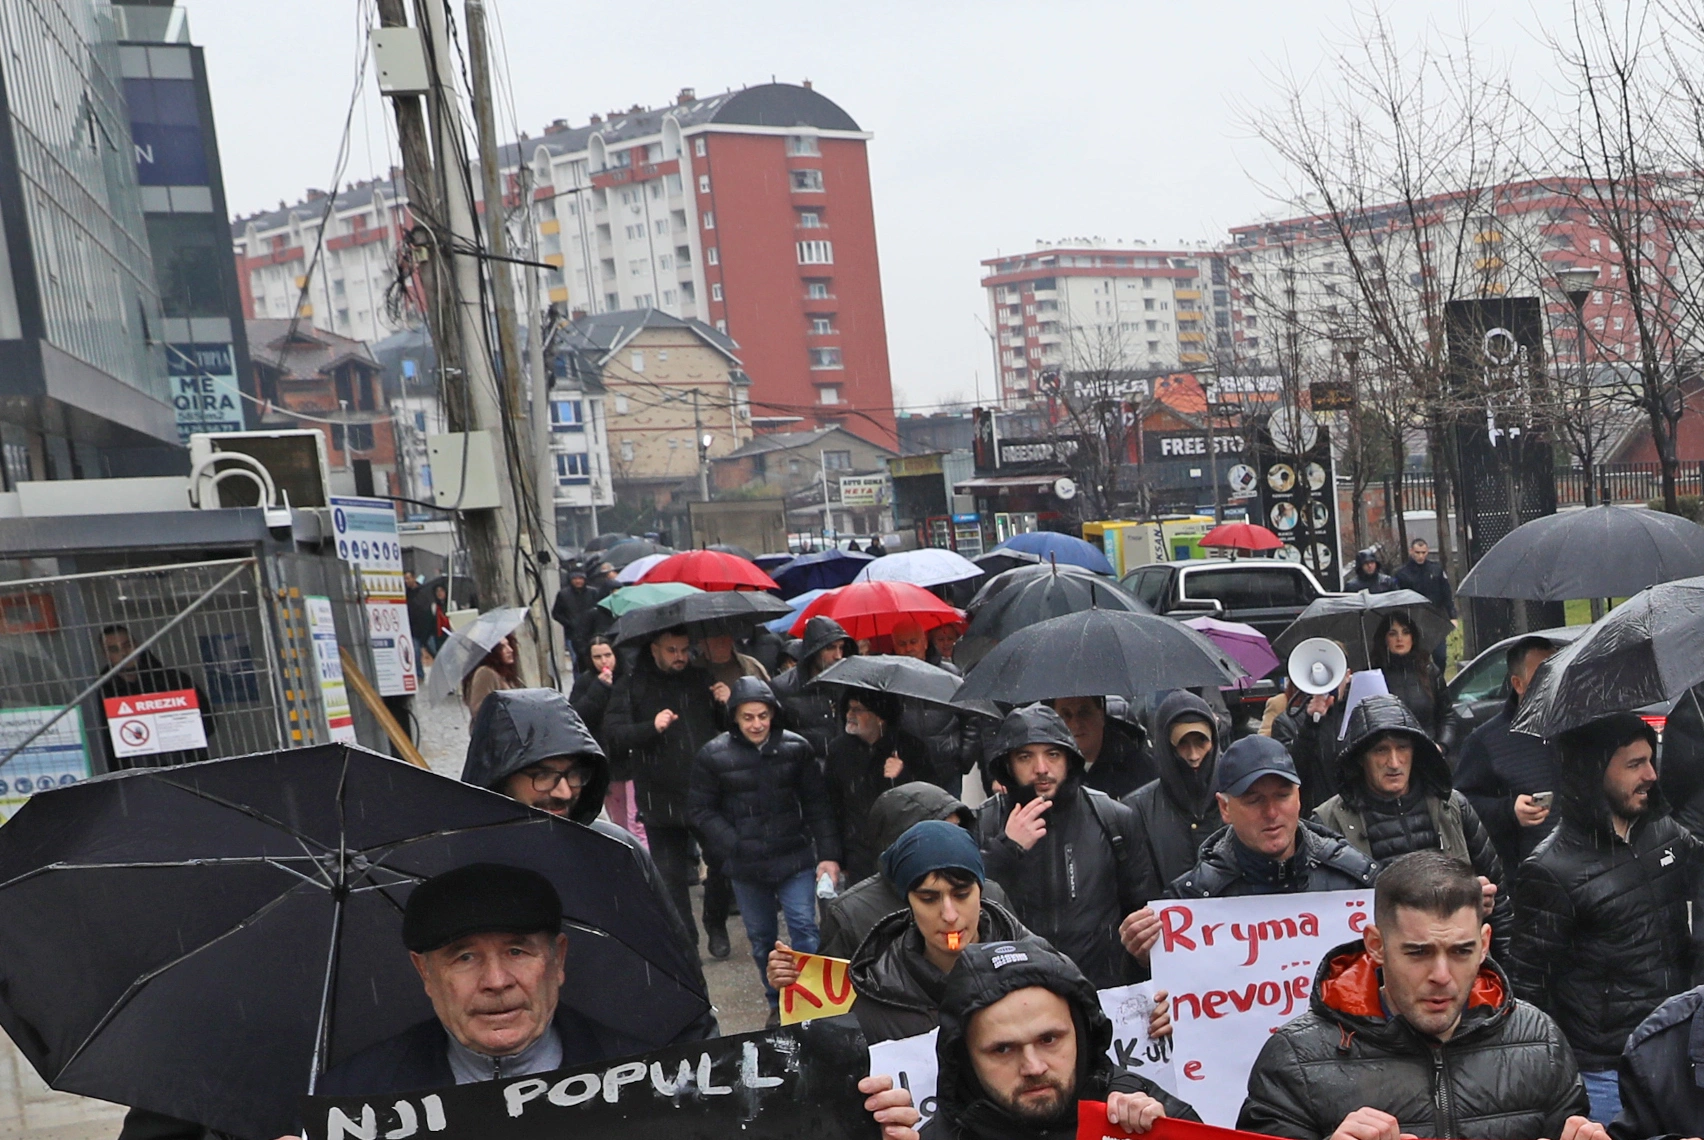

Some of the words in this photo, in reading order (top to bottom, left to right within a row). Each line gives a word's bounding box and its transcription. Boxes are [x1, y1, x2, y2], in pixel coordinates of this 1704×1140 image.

[181, 378, 214, 393] ME
[174, 394, 234, 410] QIRA
[135, 696, 188, 712] RREZIK
[1160, 905, 1319, 966] Rryma
[1344, 901, 1367, 933] ë
[503, 1041, 785, 1118] POPULL
